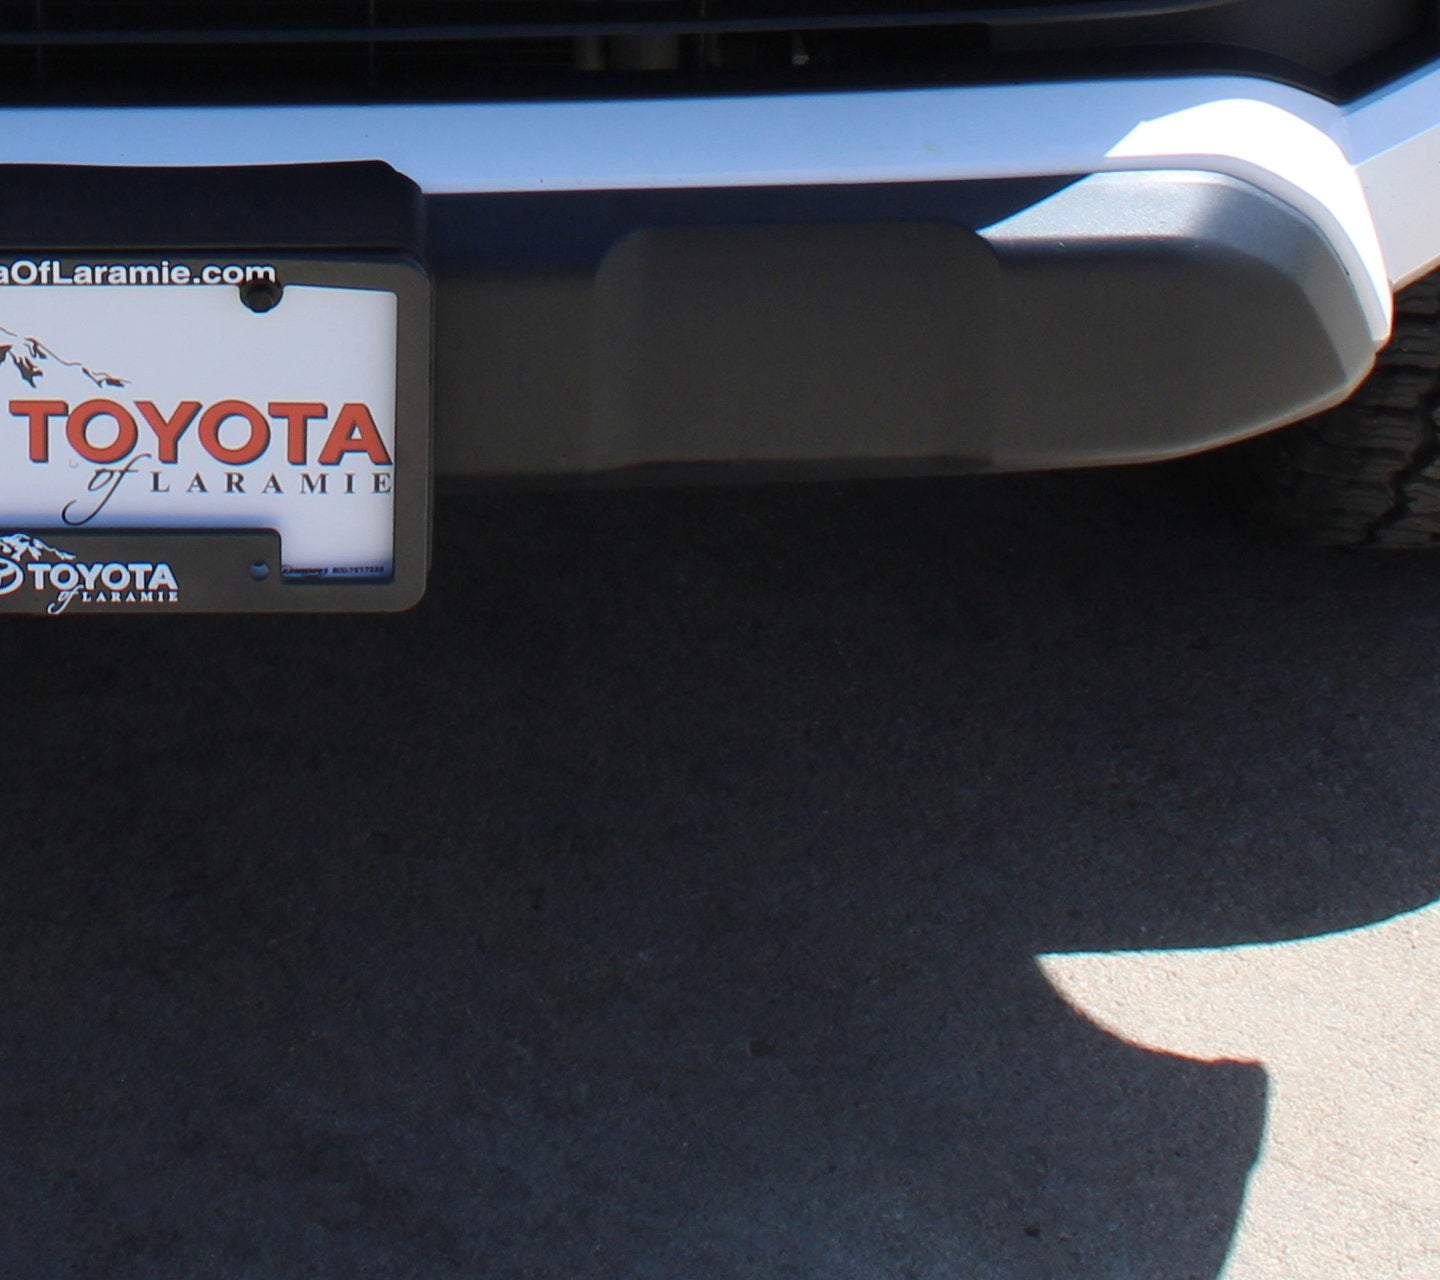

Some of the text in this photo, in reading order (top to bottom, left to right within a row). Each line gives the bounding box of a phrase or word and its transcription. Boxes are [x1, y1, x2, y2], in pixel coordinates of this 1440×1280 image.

[8, 399, 393, 466] TOYOTA
[61, 453, 393, 526] of LARAMIE
[26, 562, 179, 591] TOYOTA
[47, 585, 179, 615] of LARAMIE
